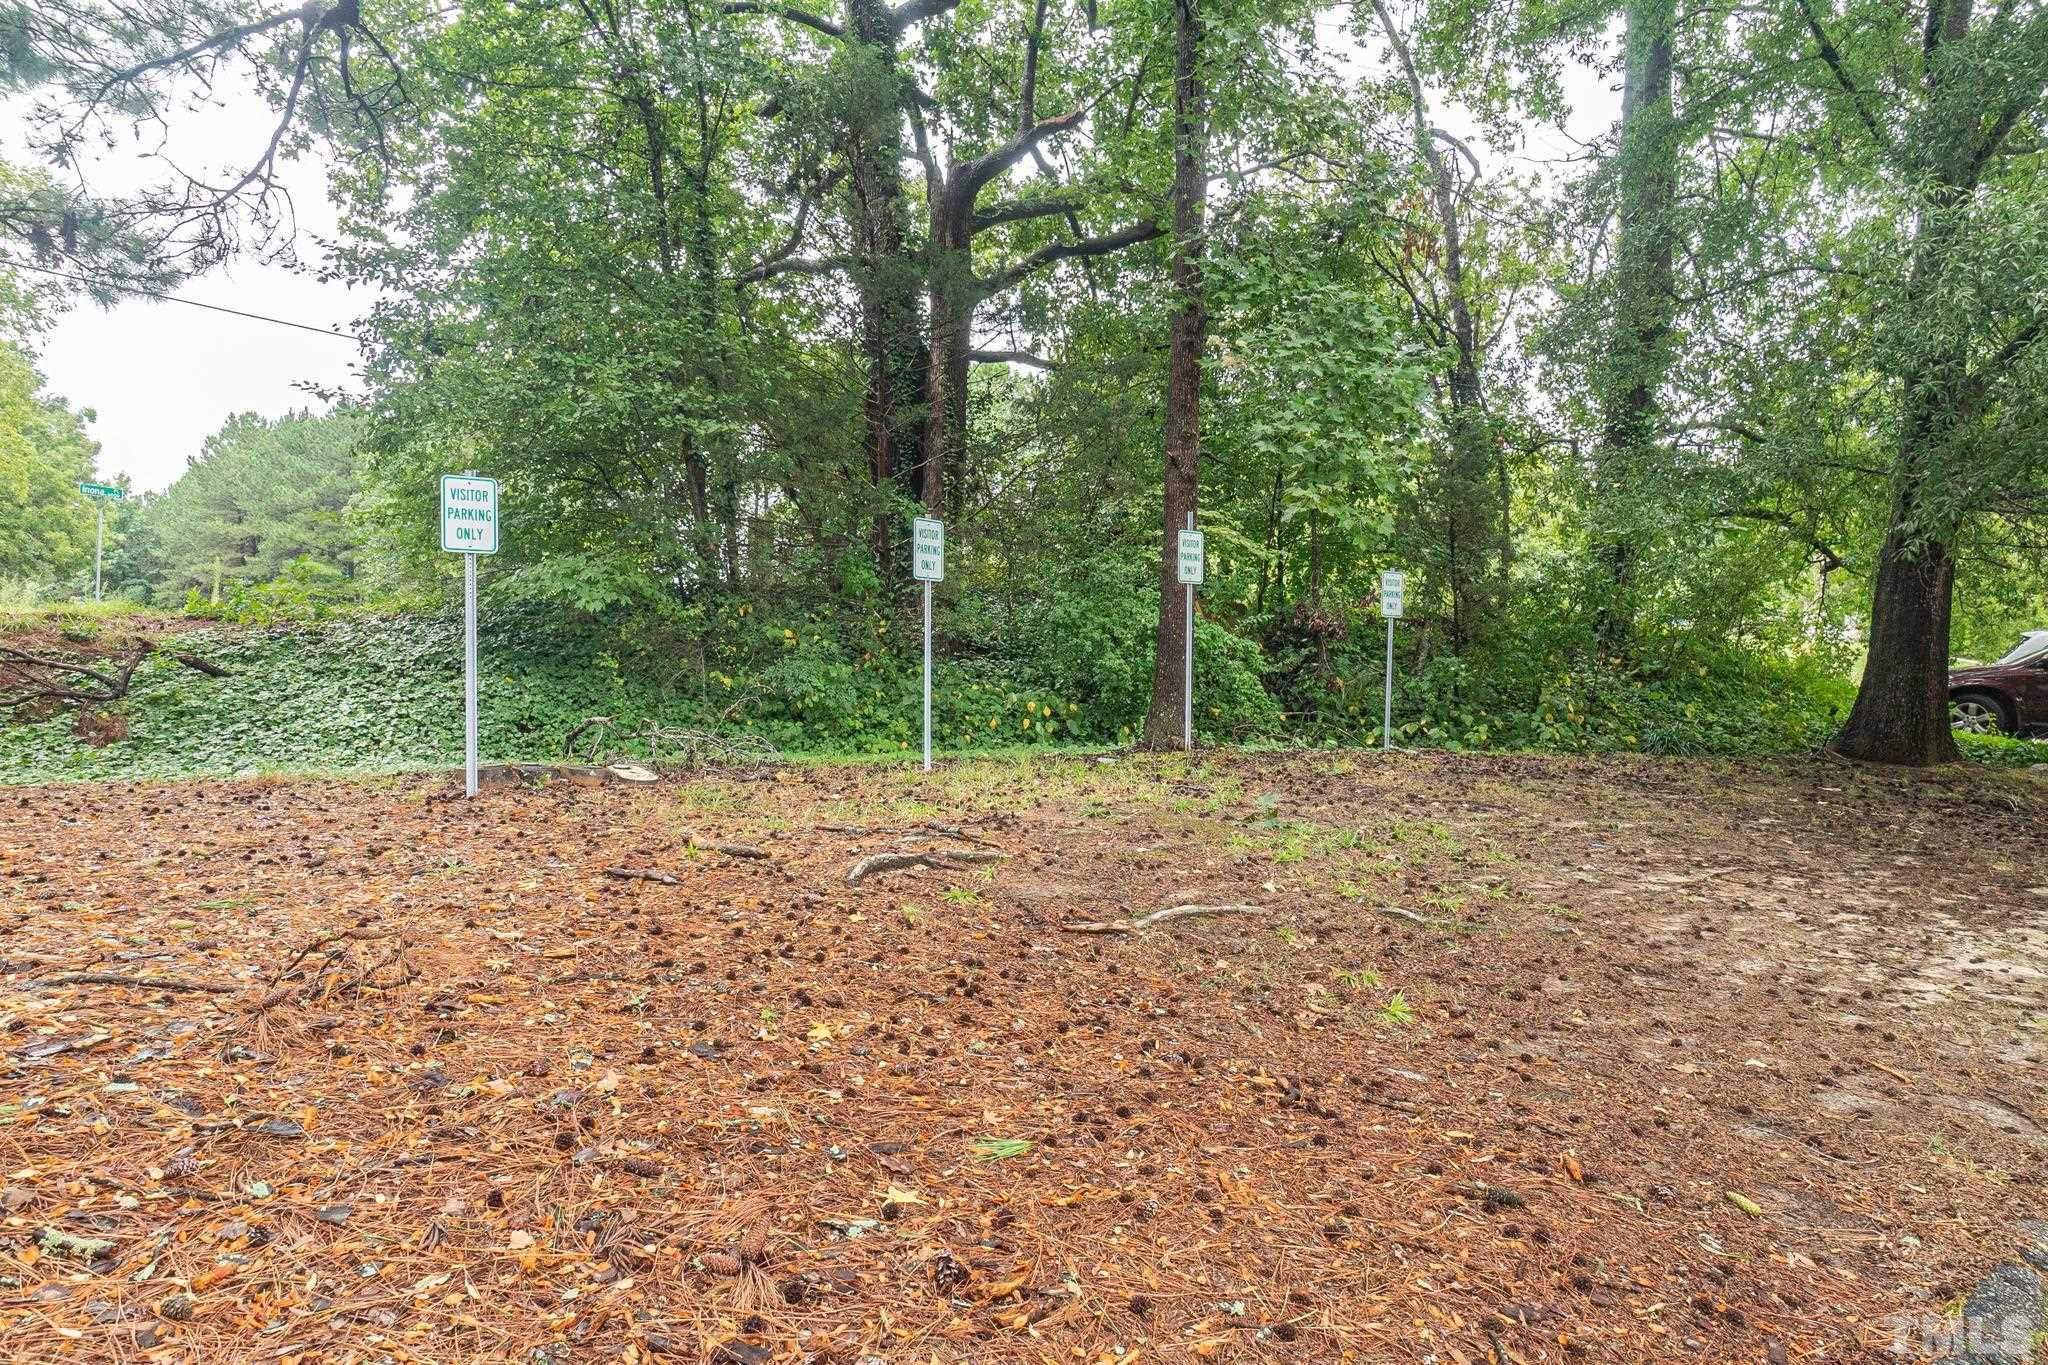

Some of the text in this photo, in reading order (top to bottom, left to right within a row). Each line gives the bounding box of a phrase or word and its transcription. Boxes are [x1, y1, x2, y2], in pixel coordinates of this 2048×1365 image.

[450, 487, 489, 502] VISITOR
[447, 507, 492, 522] PARKING
[456, 527, 484, 540] ONLY
[919, 528, 939, 541] VISITOR
[917, 543, 941, 556] PARKING
[1182, 539, 1200, 549] VISITOR
[1180, 551, 1201, 562] PARKING
[921, 559, 936, 571] ONLY
[1184, 566, 1197, 576] ONLY
